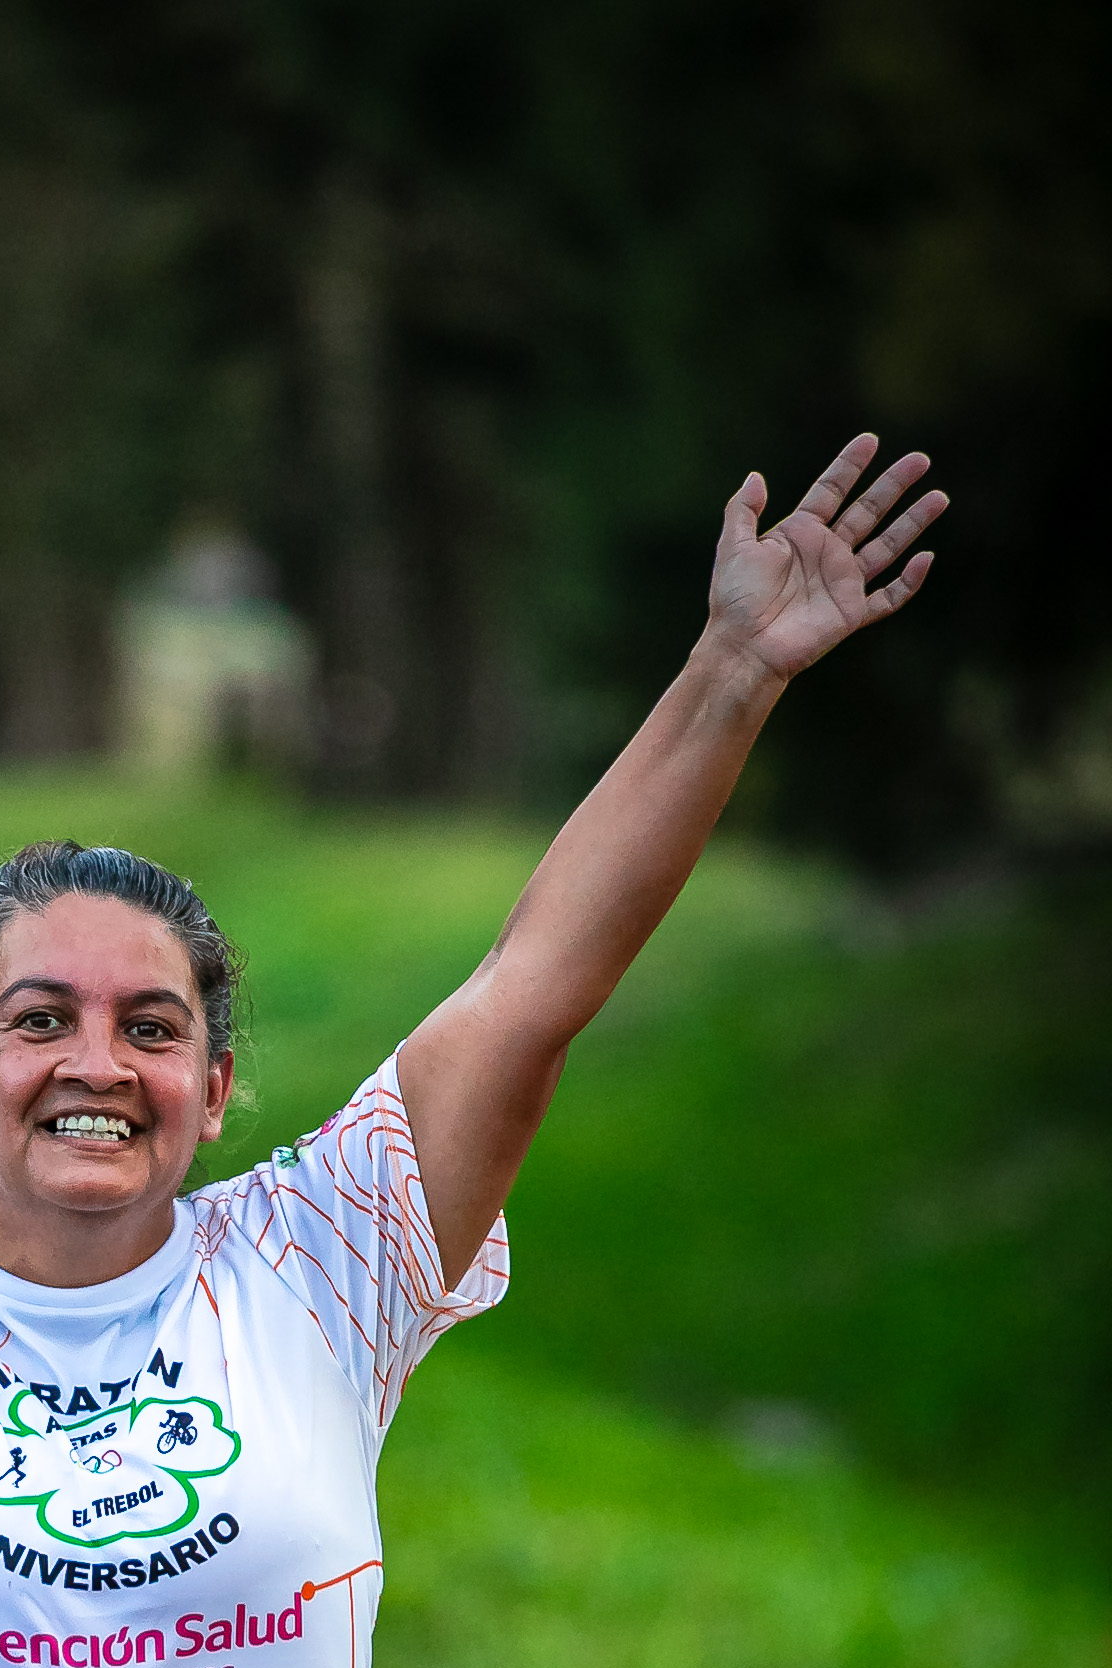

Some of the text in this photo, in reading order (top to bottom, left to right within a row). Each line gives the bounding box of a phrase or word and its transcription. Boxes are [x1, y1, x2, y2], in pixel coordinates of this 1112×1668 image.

[72, 1480, 164, 1528] EL TREBOL
[175, 1592, 304, 1659] Salud
